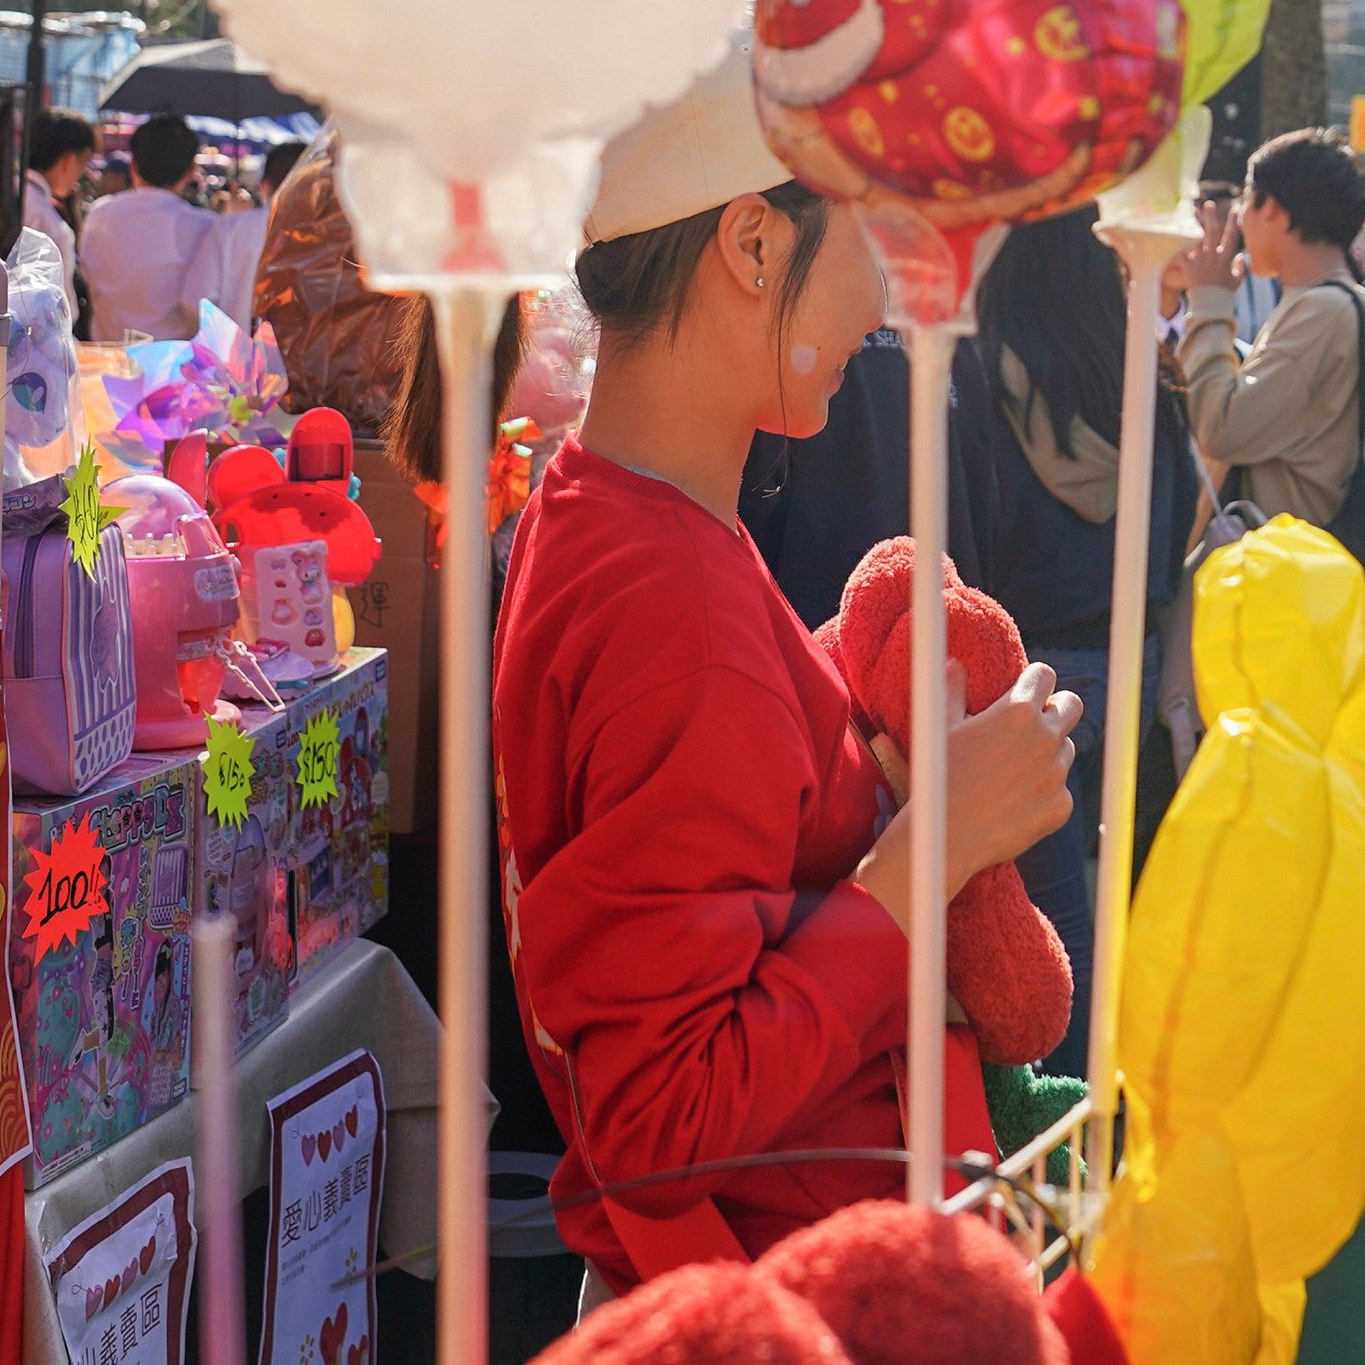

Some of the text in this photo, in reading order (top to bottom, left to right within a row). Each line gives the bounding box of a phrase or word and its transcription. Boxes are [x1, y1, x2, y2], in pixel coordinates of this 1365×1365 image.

[282, 1153, 371, 1248] 愛心義賣區
